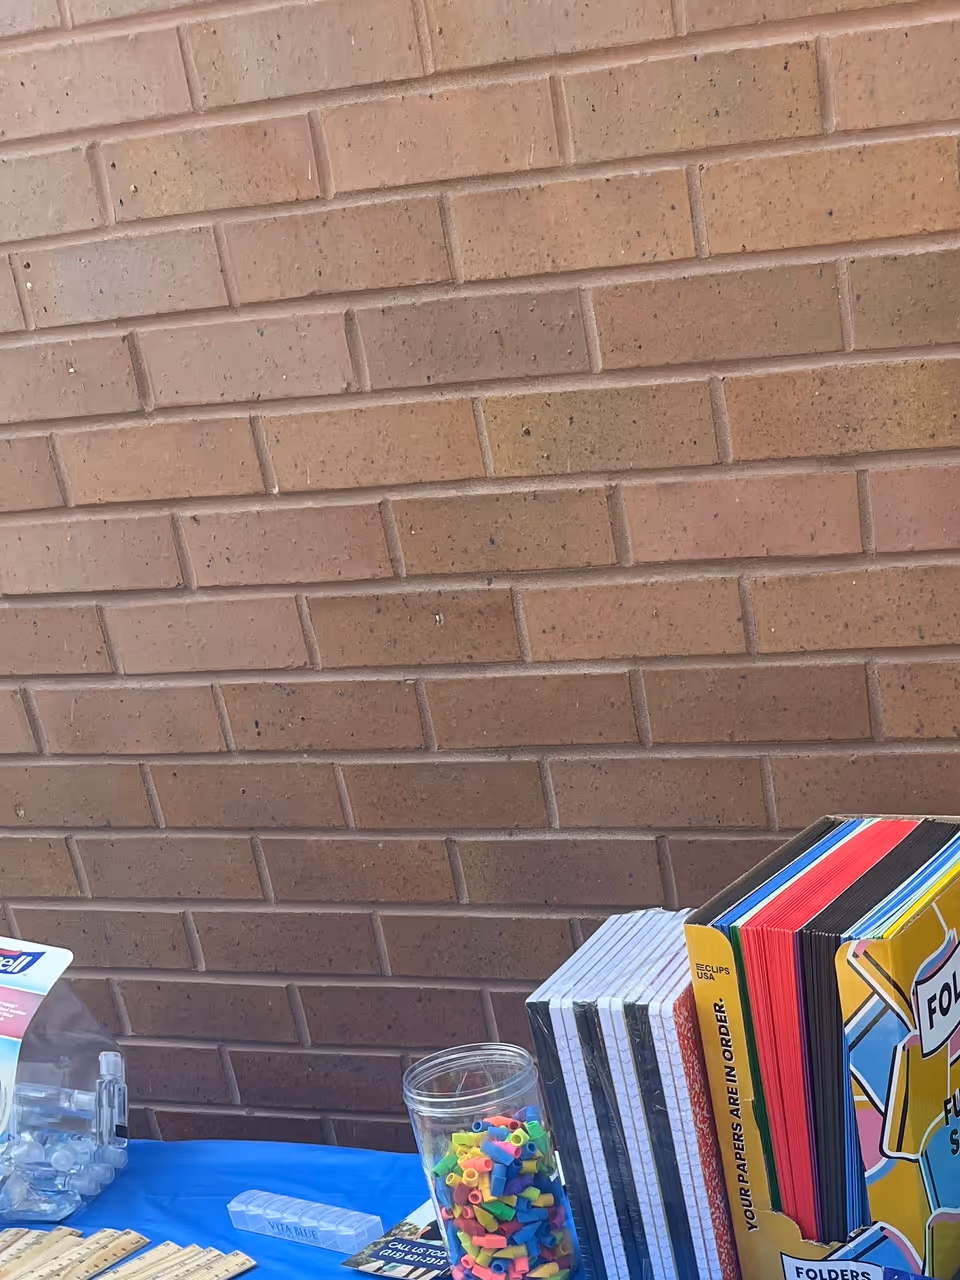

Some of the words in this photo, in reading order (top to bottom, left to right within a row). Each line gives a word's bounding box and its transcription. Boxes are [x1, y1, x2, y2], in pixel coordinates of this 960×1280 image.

[697, 971, 715, 982] USA
[714, 998, 736, 1063] ORDER.
[724, 1064, 738, 1077] IN
[727, 1081, 740, 1120] ARE
[730, 1123, 749, 1185] PAPERS
[739, 1186, 760, 1232] YOUR
[267, 1220, 292, 1236] VITA
[294, 1227, 319, 1240] BLUE
[379, 1249, 404, 1259] (215)
[388, 1242, 409, 1251] CALL
[411, 1246, 426, 1254] US
[426, 1249, 447, 1257] TOD
